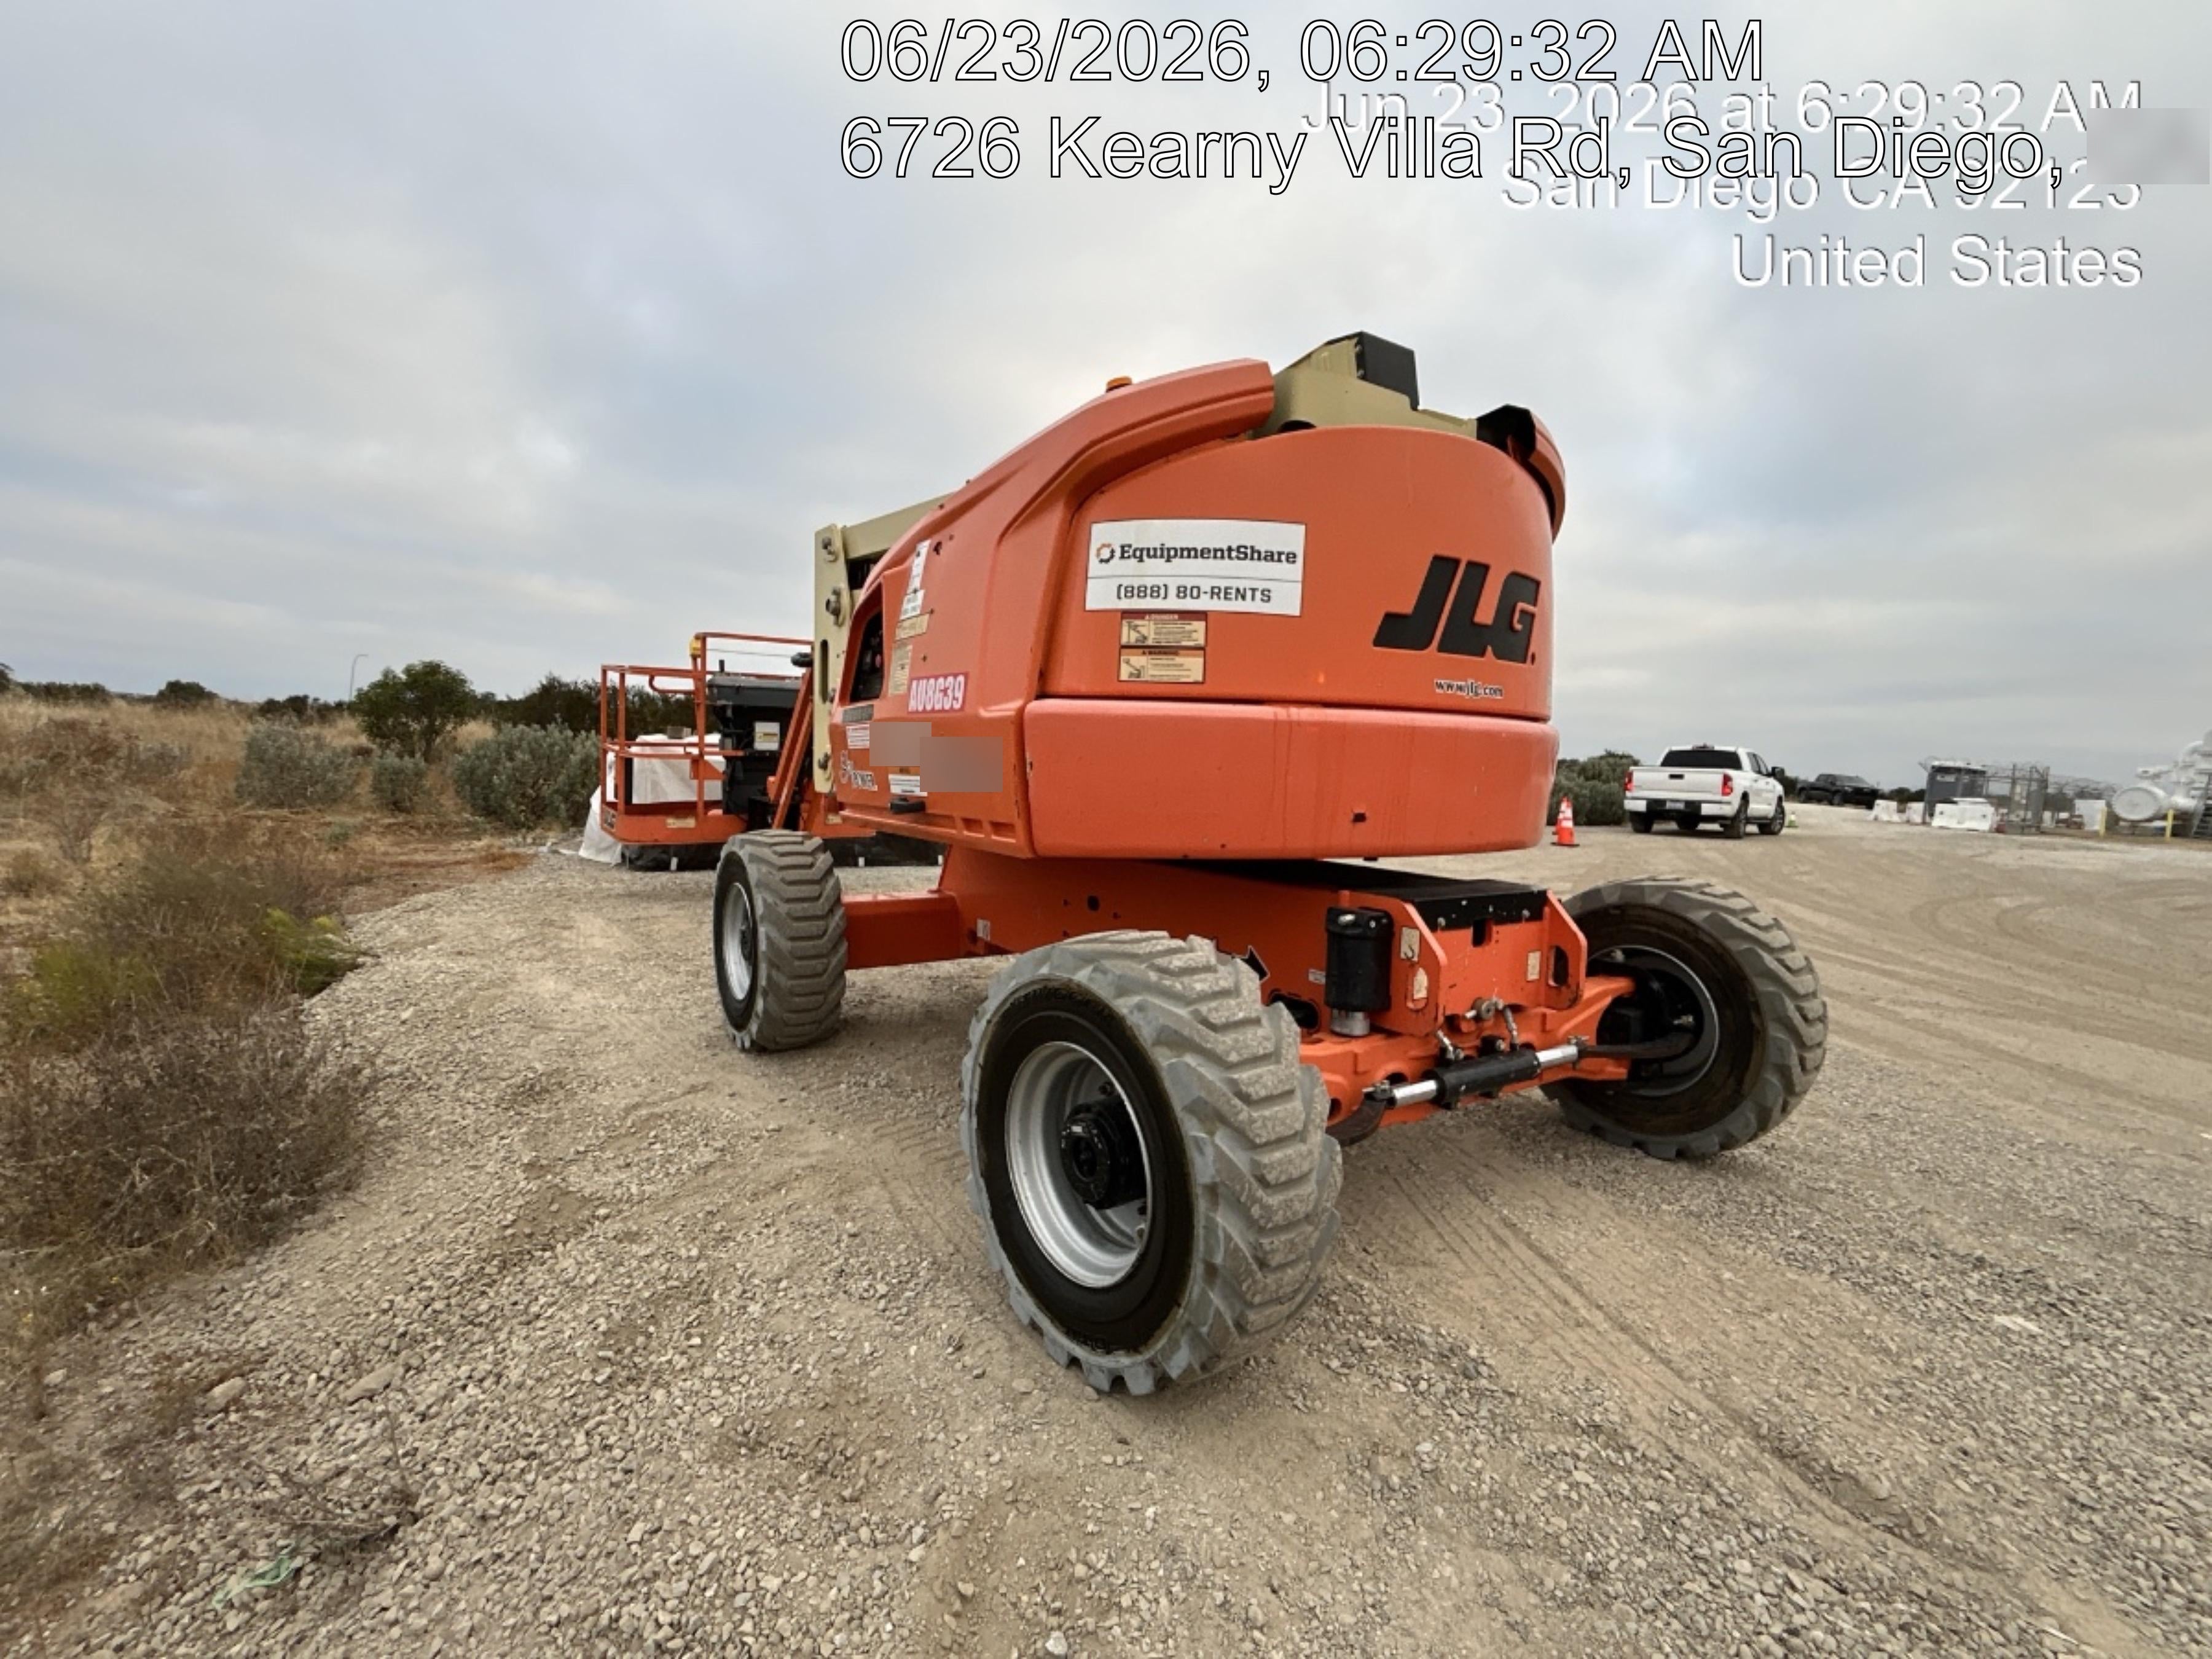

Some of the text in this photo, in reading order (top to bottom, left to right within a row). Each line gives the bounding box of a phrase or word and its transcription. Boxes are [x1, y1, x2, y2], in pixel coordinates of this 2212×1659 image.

[1118, 544, 1298, 565] EquipmentShare
[1116, 584, 1272, 603] (888) 80-RENTS
[1372, 554, 1541, 664] JLG
